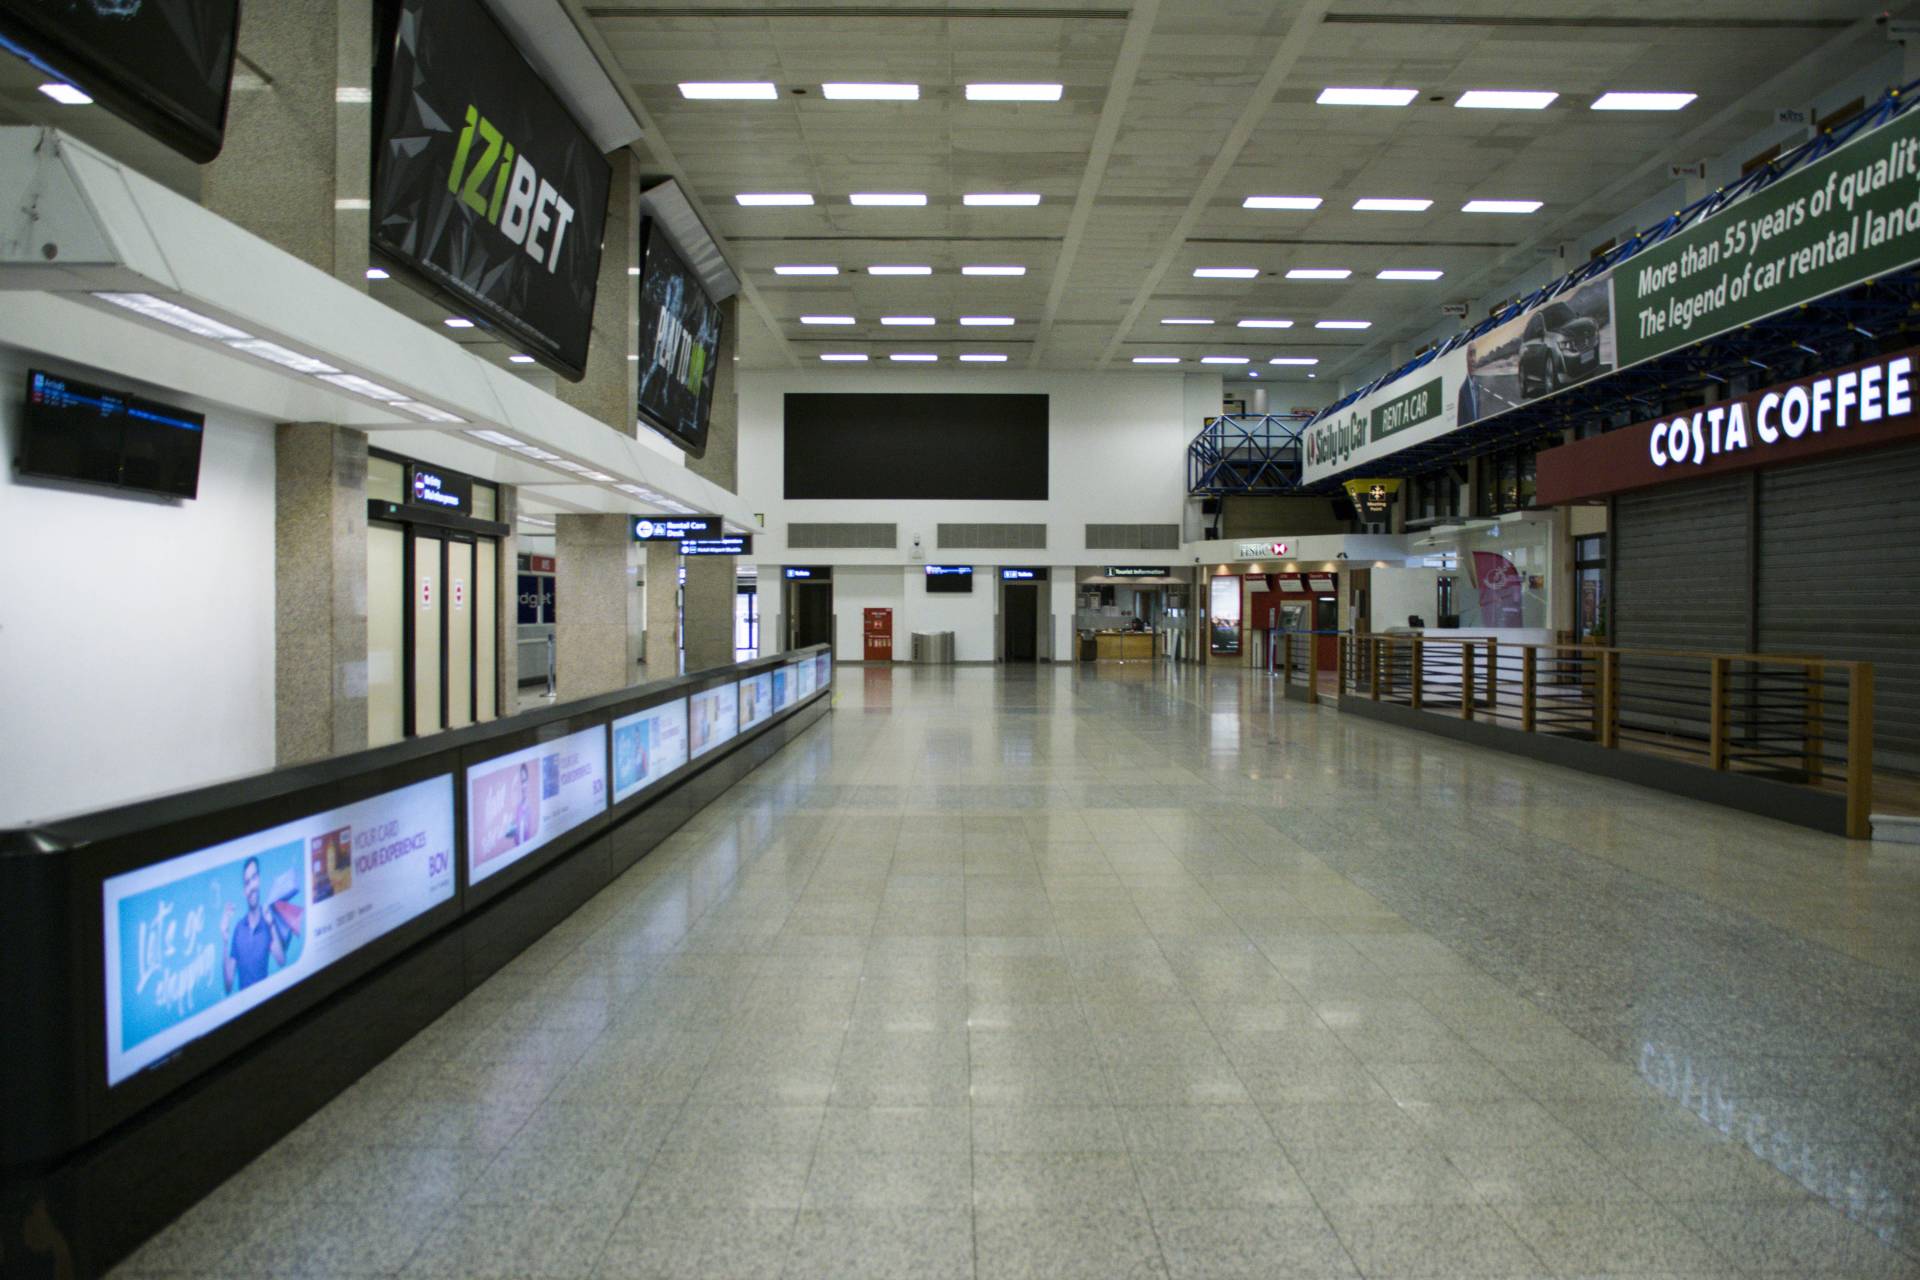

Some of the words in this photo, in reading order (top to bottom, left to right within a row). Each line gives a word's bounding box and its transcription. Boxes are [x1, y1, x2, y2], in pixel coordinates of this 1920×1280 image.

[1638, 261, 1677, 298] More
[1681, 244, 1719, 277] than
[1723, 220, 1747, 258] 55
[1750, 196, 1805, 255] years
[1810, 171, 1837, 217] of
[1840, 136, 1920, 211] qualit
[1639, 304, 1665, 338] The
[1669, 274, 1727, 330] legend
[1730, 262, 1752, 302] of
[1754, 256, 1786, 292] car
[1789, 215, 1858, 279] rental
[1316, 423, 1338, 466] Sicily
[1338, 419, 1350, 461] by
[1351, 411, 1368, 452] Car
[1382, 402, 1403, 432] RENT
[1403, 398, 1410, 424] A
[1411, 390, 1428, 421] CAR
[1650, 402, 1748, 467] COSTA
[1757, 357, 1911, 444] COFFEE
[428, 850, 449, 877] BOV
